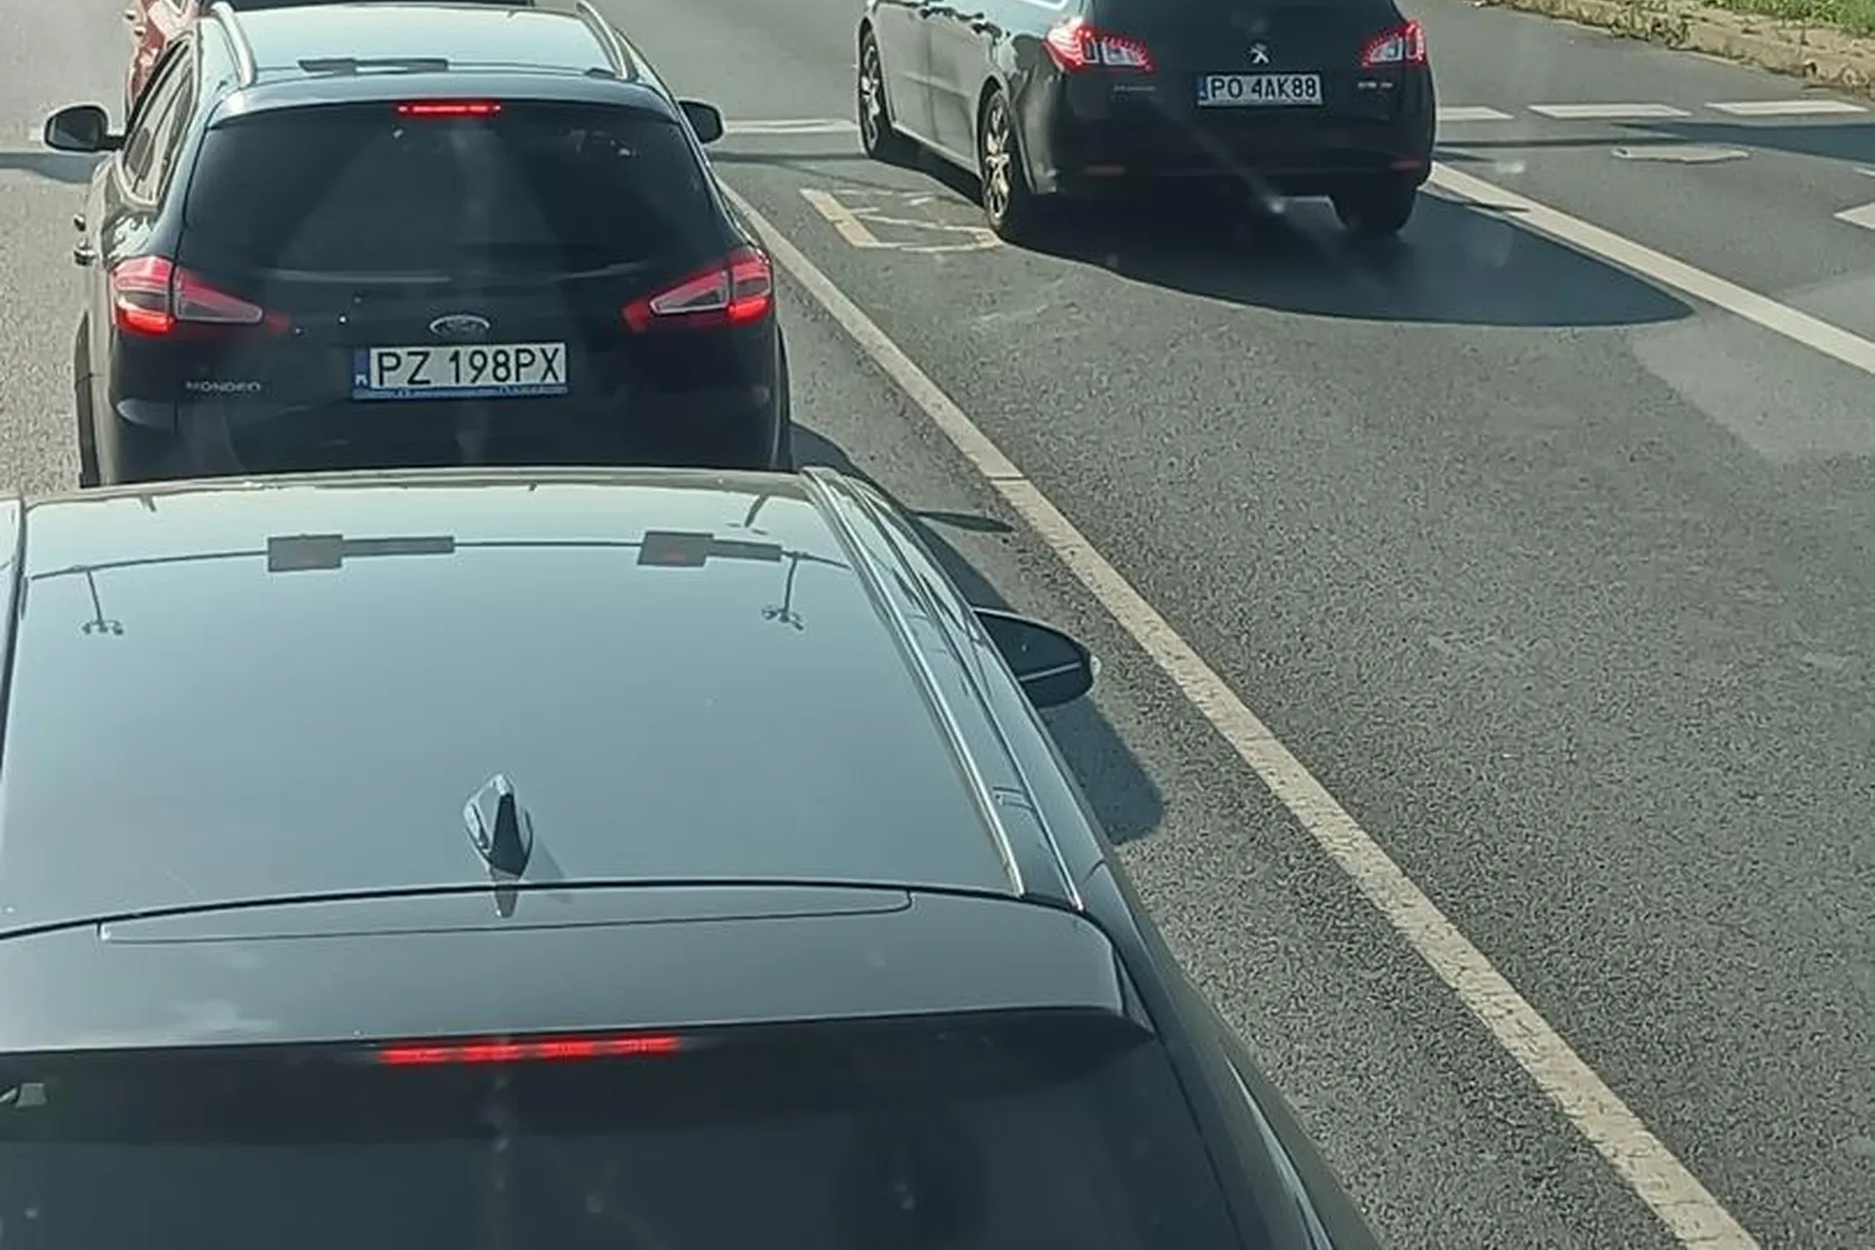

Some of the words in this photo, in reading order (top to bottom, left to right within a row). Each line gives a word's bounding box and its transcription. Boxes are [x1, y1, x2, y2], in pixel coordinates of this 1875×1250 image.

[1210, 77, 1243, 99] PO
[1251, 77, 1317, 99] 4AK88
[376, 351, 432, 387] PZ
[449, 347, 560, 385] 198PX
